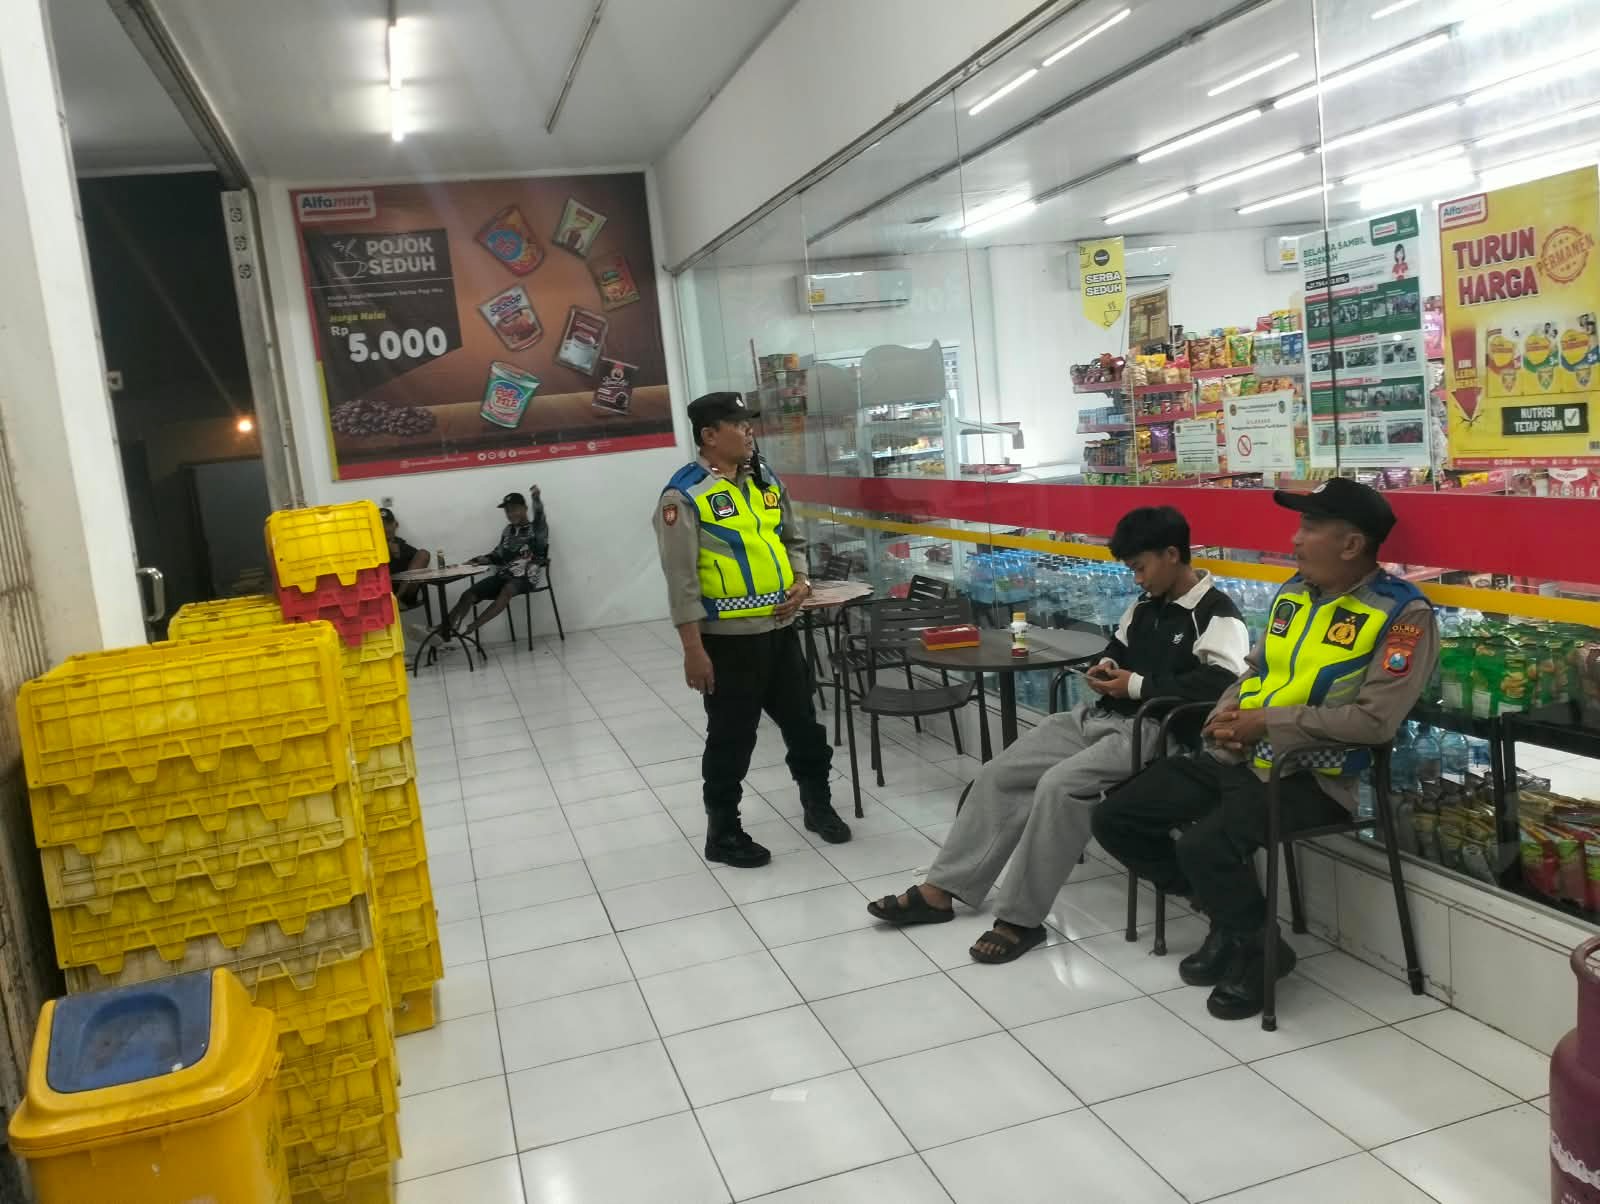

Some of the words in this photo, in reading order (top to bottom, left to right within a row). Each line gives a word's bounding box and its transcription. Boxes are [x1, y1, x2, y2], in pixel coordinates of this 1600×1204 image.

[302, 195, 370, 210] Alfamart
[365, 236, 434, 255] POJOK
[1452, 226, 1535, 269] TURUN
[367, 256, 437, 275] SEDUH
[1085, 271, 1121, 284] SERBA
[1458, 264, 1539, 305] HARGA
[1085, 283, 1123, 297] SEDUH
[331, 326, 349, 337] Rp
[349, 326, 448, 362] 5.000
[1520, 407, 1556, 419] NUTRISI
[1514, 421, 1539, 432] TETAP
[1541, 420, 1564, 432] SAMA
